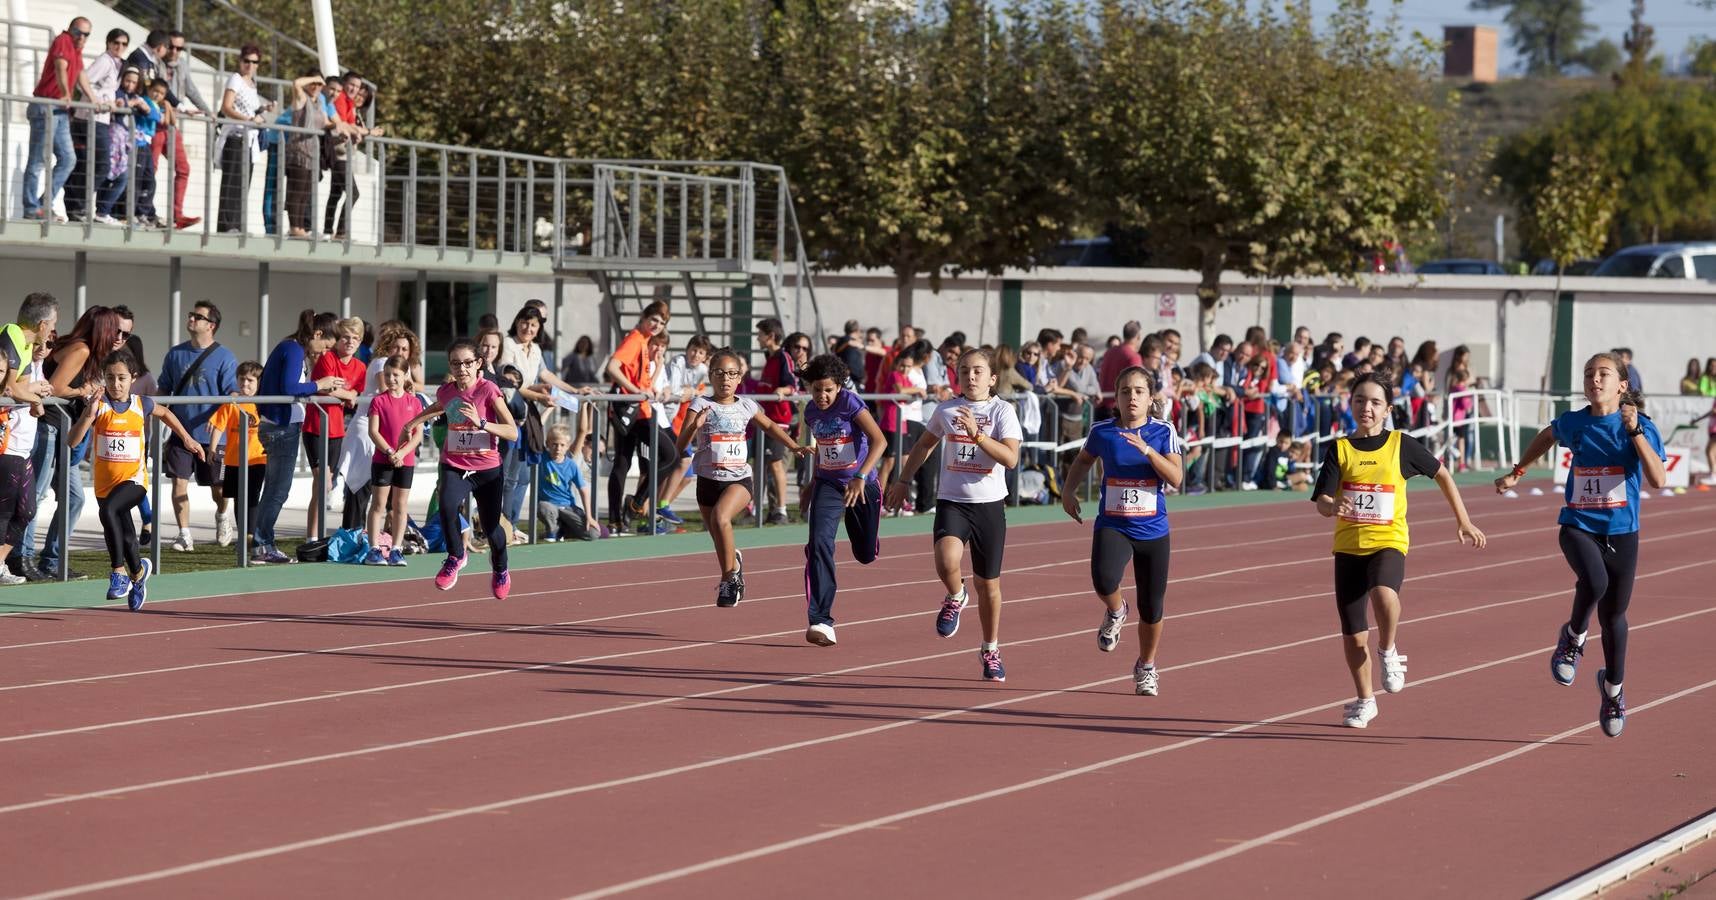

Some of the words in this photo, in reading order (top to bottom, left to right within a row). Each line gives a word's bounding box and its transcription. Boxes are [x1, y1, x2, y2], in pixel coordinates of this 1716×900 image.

[109, 439, 125, 452] 48
[458, 433, 474, 446] 47
[726, 443, 741, 456] 46
[824, 447, 839, 460] 45
[958, 445, 976, 459] 44
[1665, 454, 1682, 472] 7
[1583, 478, 1602, 495] 41
[1120, 489, 1139, 504] 43
[1354, 494, 1374, 510] 42
